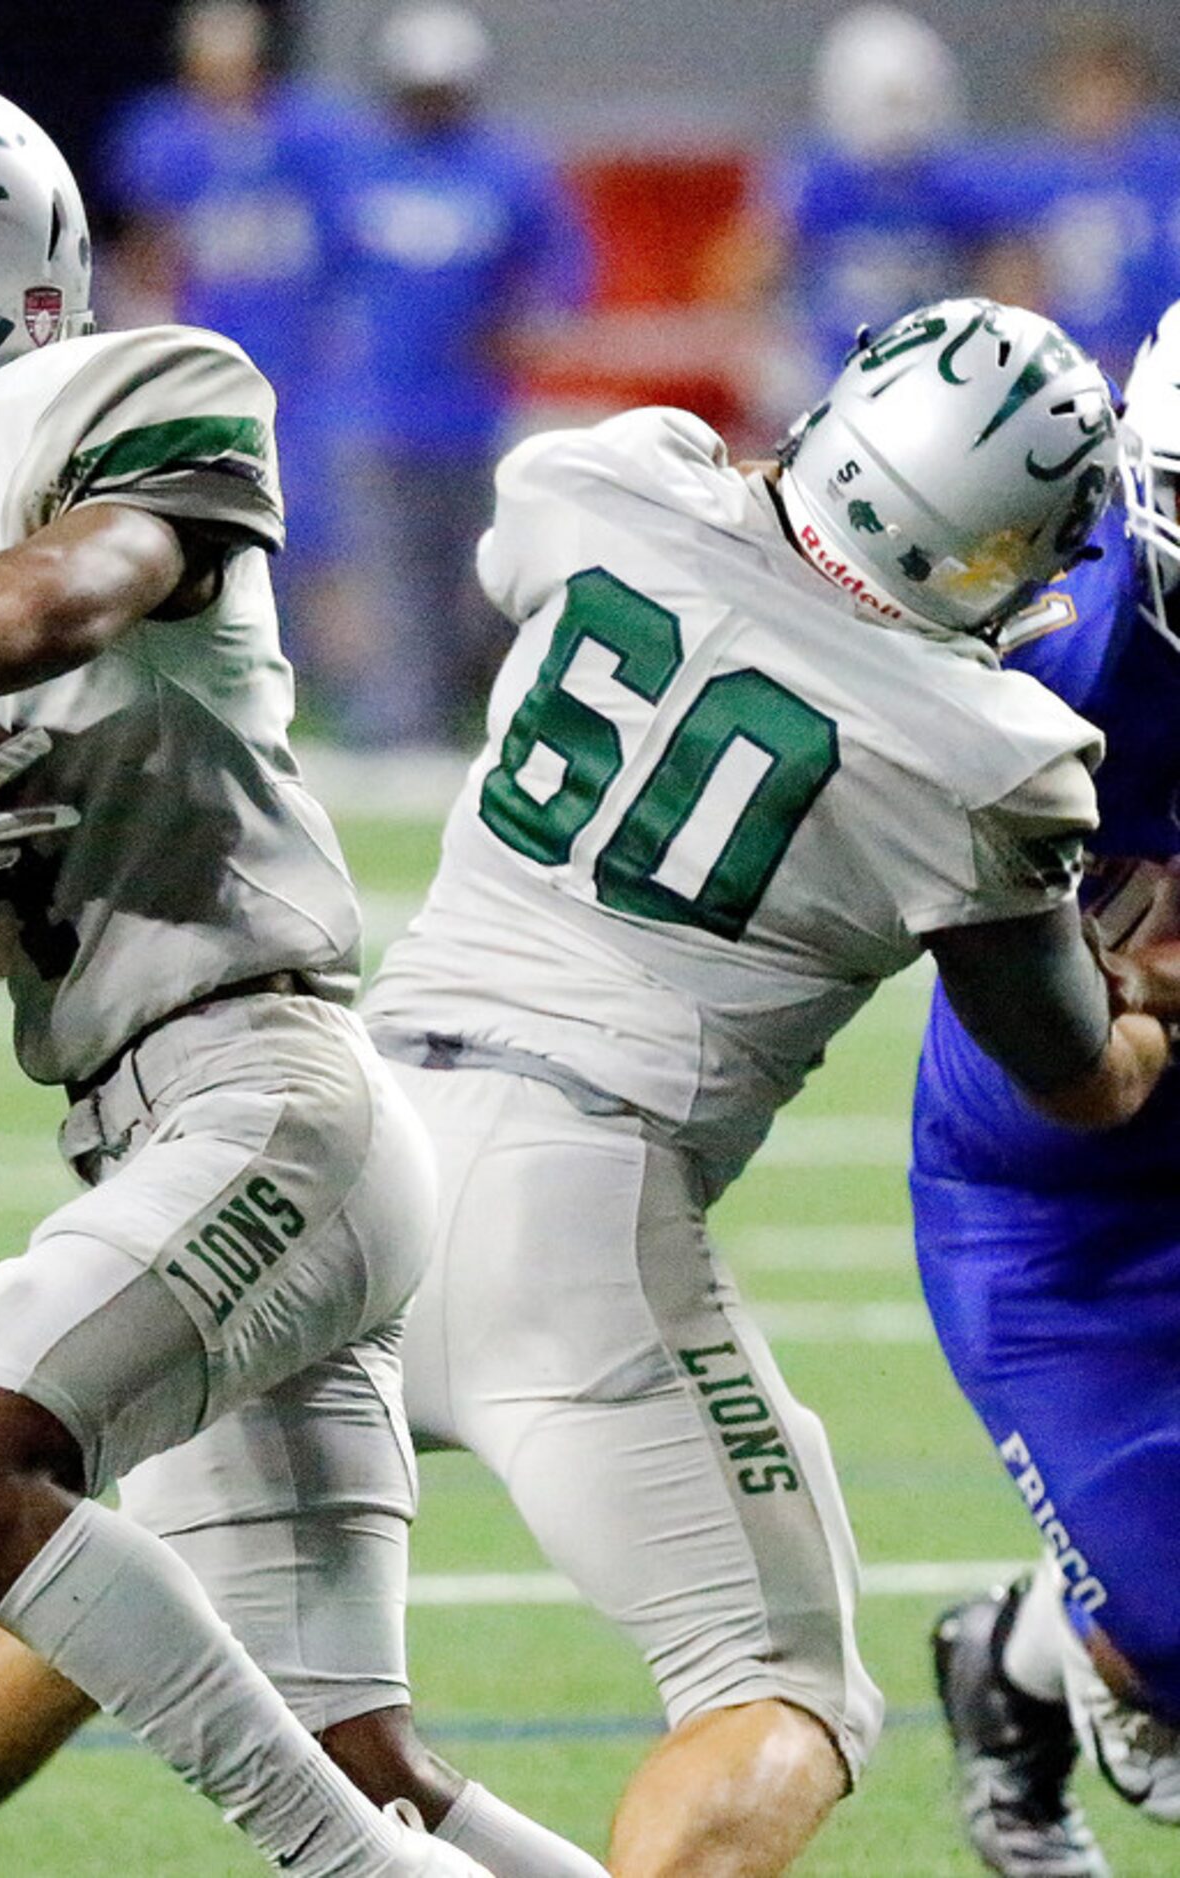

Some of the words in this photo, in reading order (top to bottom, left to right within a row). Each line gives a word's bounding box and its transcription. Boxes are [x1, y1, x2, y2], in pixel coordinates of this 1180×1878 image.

[479, 565, 841, 943] 60
[165, 1176, 307, 1327] LIONS
[678, 1341, 799, 1494] LIONS
[1000, 1430, 1108, 1614] FRISCO
